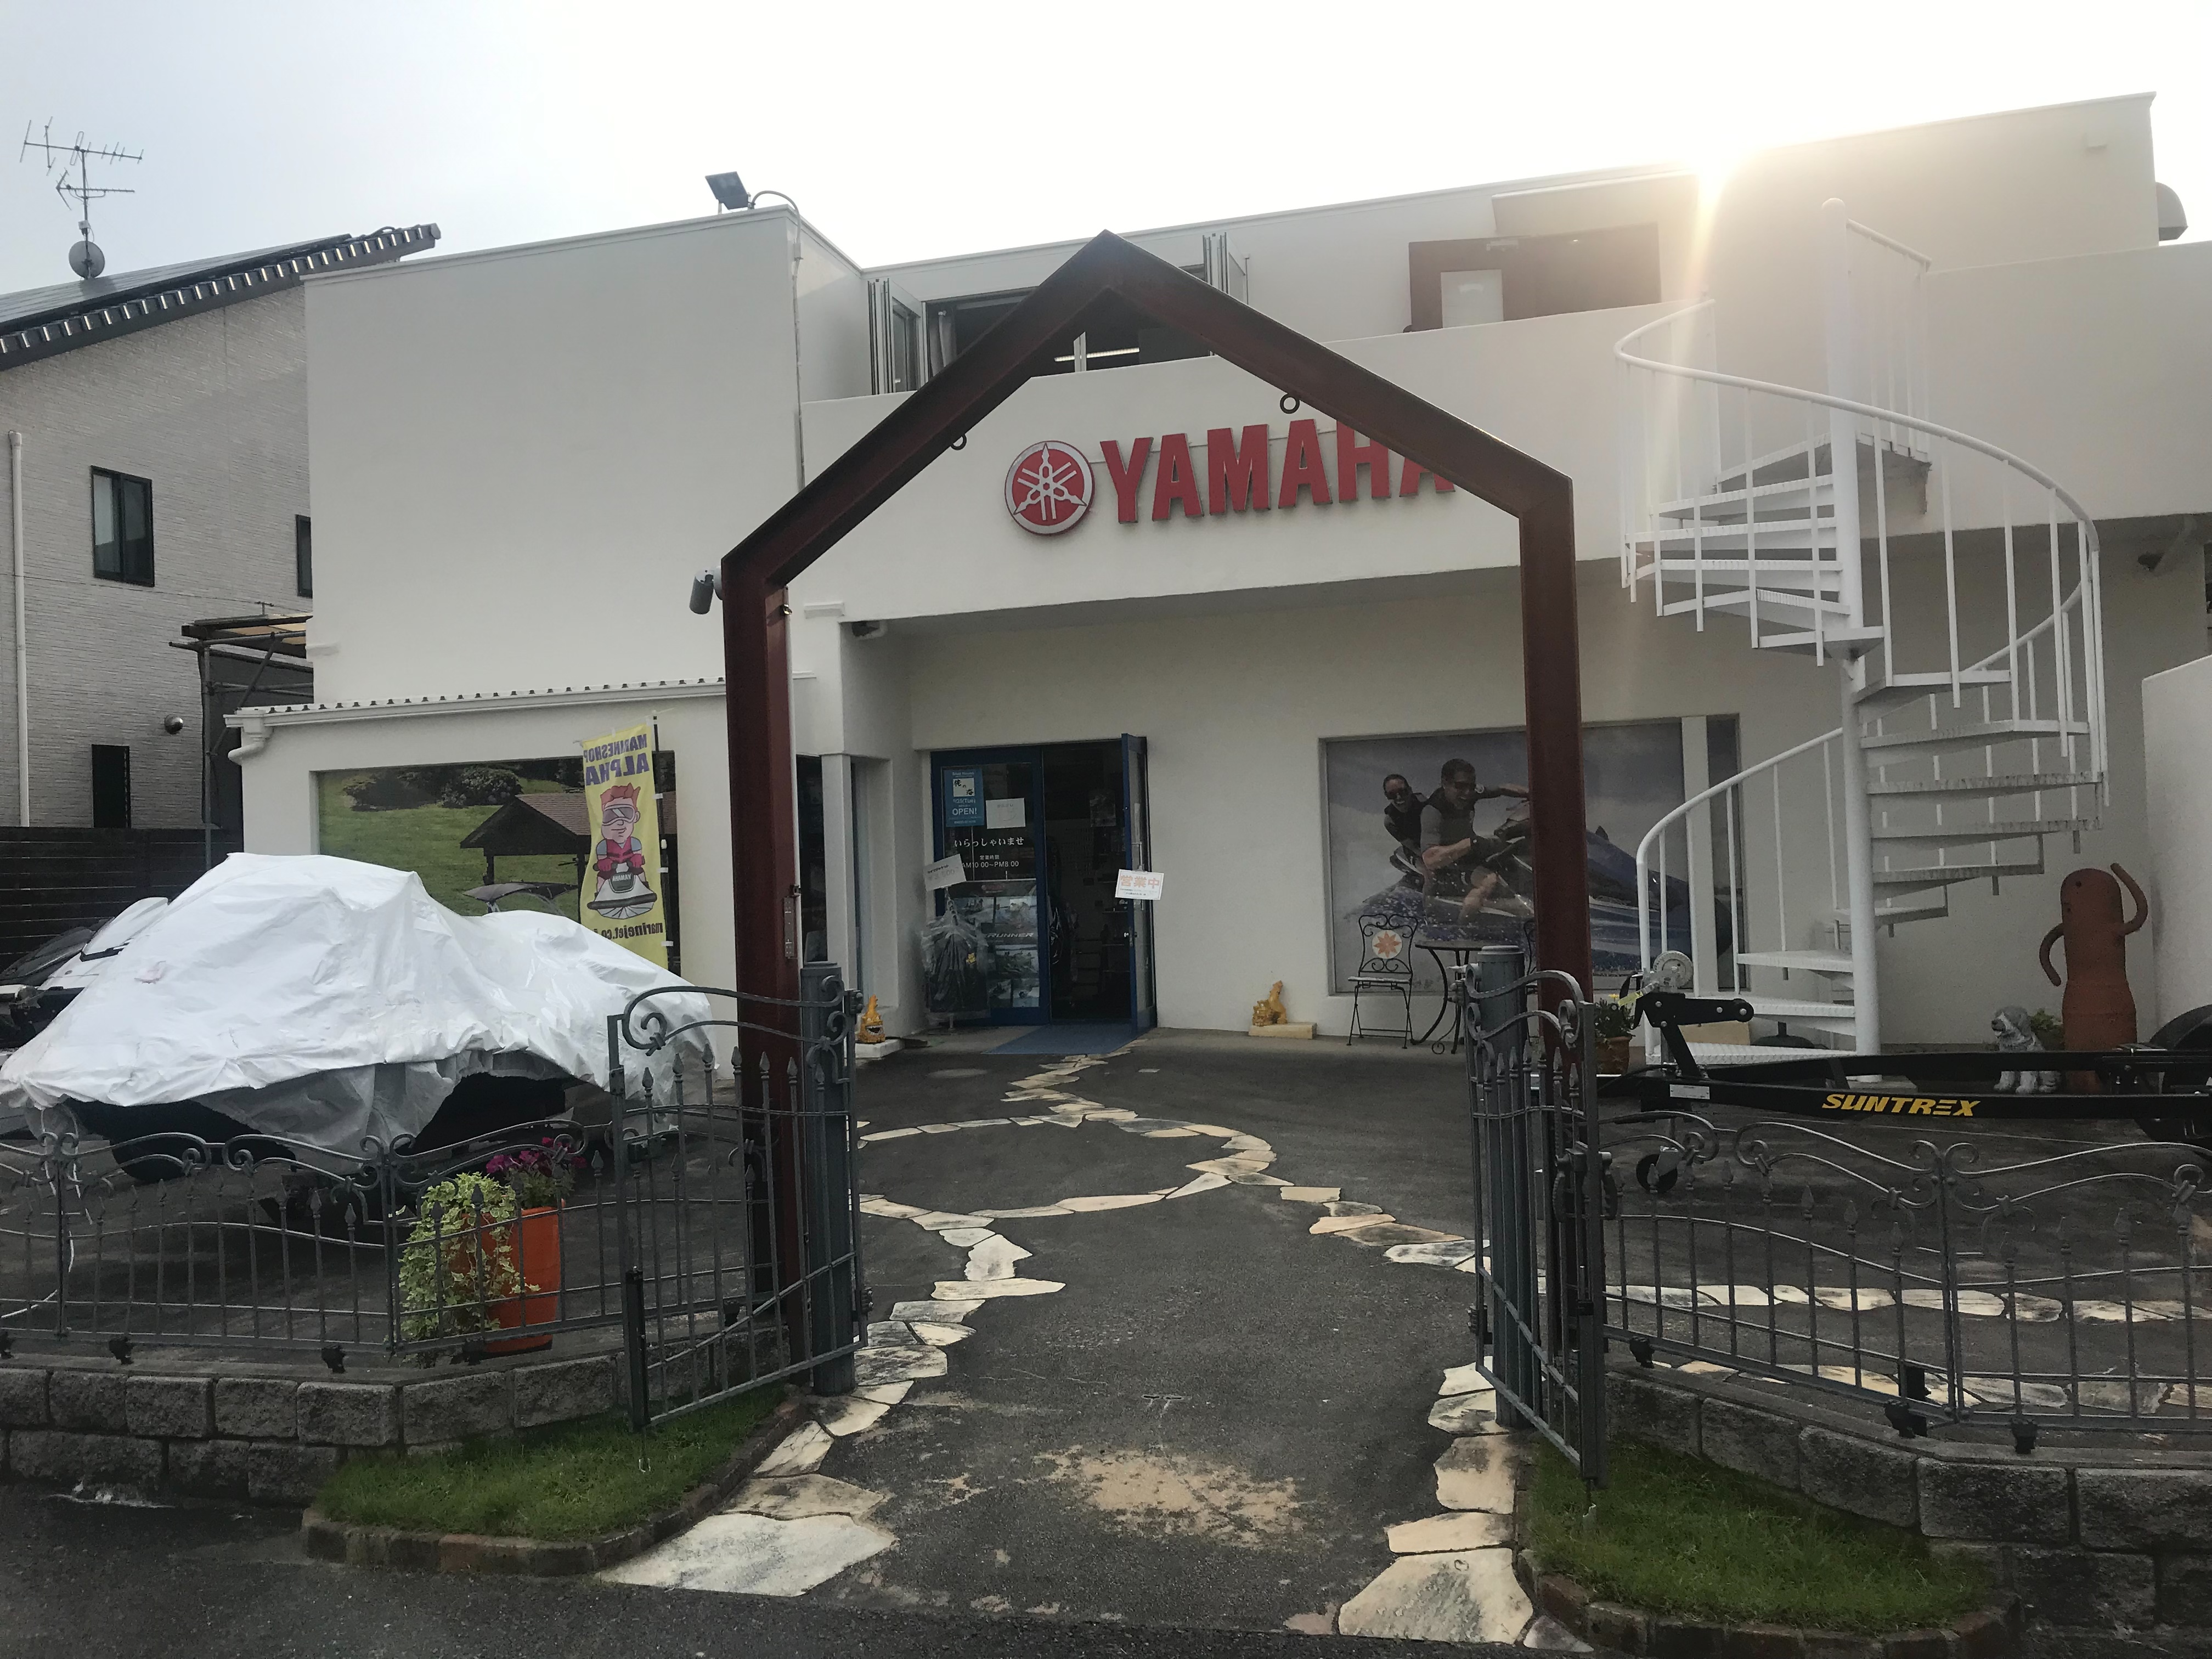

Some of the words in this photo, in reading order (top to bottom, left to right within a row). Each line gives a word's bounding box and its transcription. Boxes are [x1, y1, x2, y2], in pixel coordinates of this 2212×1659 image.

[952, 808, 977, 816] OPEN!
[954, 837, 1024, 848] いらっしゃいませ
[1120, 875, 1160, 889] 営業中
[1821, 1093, 1981, 1116] SUNTREX
